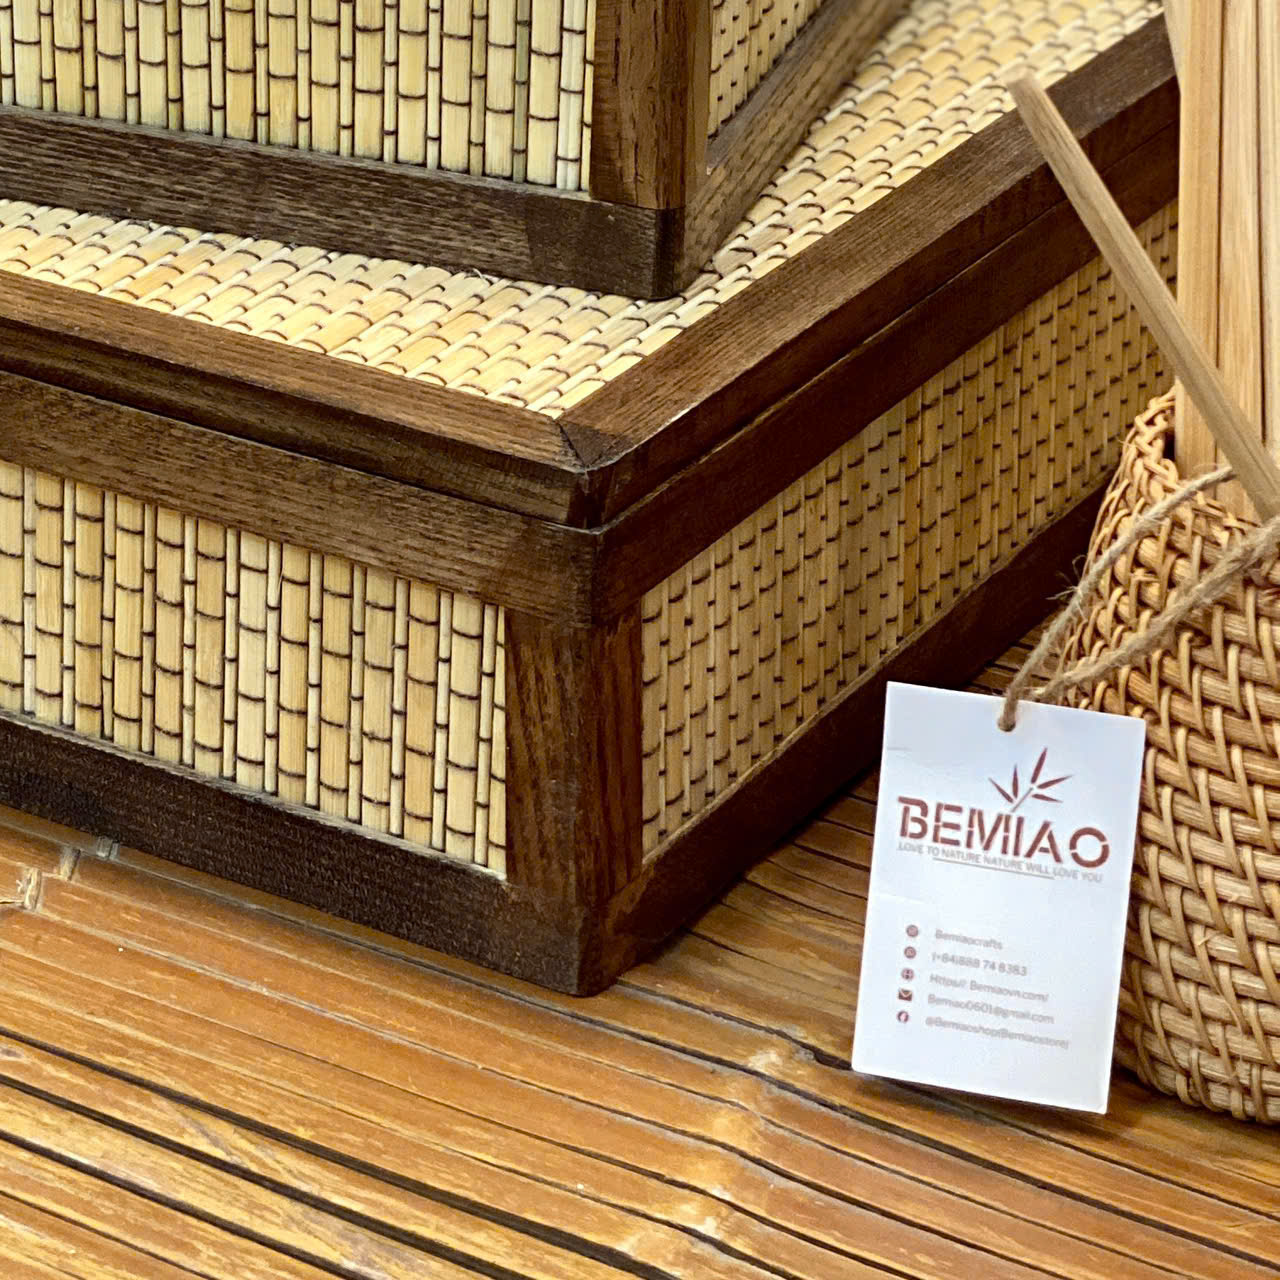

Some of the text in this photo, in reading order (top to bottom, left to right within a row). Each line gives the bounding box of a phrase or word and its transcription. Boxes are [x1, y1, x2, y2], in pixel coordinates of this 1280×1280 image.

[897, 796, 1110, 868] BEMIAO
[897, 842, 1103, 883] LOVE TO NATURE NATURE WILL LOVE YOU
